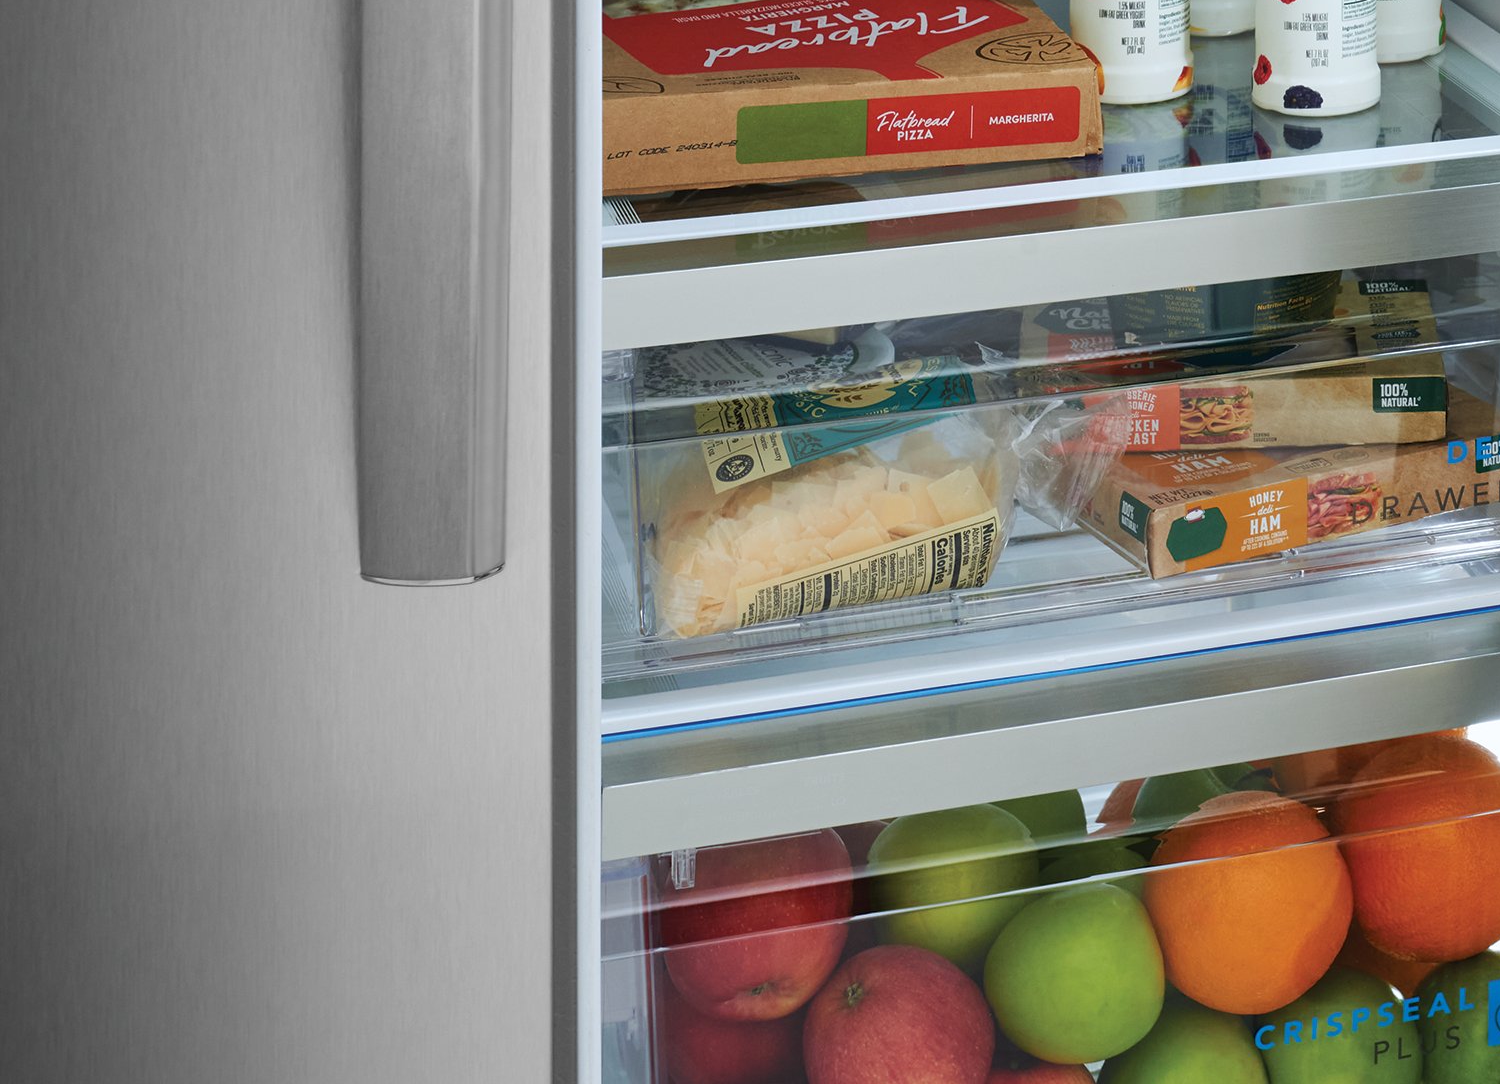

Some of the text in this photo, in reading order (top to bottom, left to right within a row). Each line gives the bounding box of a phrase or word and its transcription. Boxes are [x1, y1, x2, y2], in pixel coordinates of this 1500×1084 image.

[701, 11, 722, 21] AND
[724, 0, 782, 17] MOZZARELLA
[739, 0, 850, 22] MARGHERITA
[745, 7, 880, 37] PIZZA
[703, 5, 990, 67] Flatbread
[876, 109, 955, 132] Flatbread
[988, 112, 1055, 126] MARGHERITA
[897, 129, 934, 142] PIZZA
[607, 145, 671, 160] LOT CODE
[1256, 301, 1287, 311] Nutrition
[1380, 382, 1409, 397] 100%
[1381, 396, 1419, 408] NATURAL
[1170, 456, 1233, 474] HAM
[1178, 453, 1206, 463] deli
[1148, 492, 1168, 501] NET
[1180, 489, 1214, 501] (227g)
[1248, 490, 1284, 508] HONEY
[1121, 498, 1135, 519] 100%
[1257, 504, 1275, 516] deli
[1249, 513, 1282, 536] HAM
[963, 529, 972, 552] Serving
[971, 527, 981, 545] About
[978, 523, 995, 569] Nutrition
[880, 556, 888, 577] Sodium
[934, 538, 948, 585] Calories
[1254, 987, 1476, 1051] CRISPSEAL
[1373, 1025, 1461, 1066] PLUS
